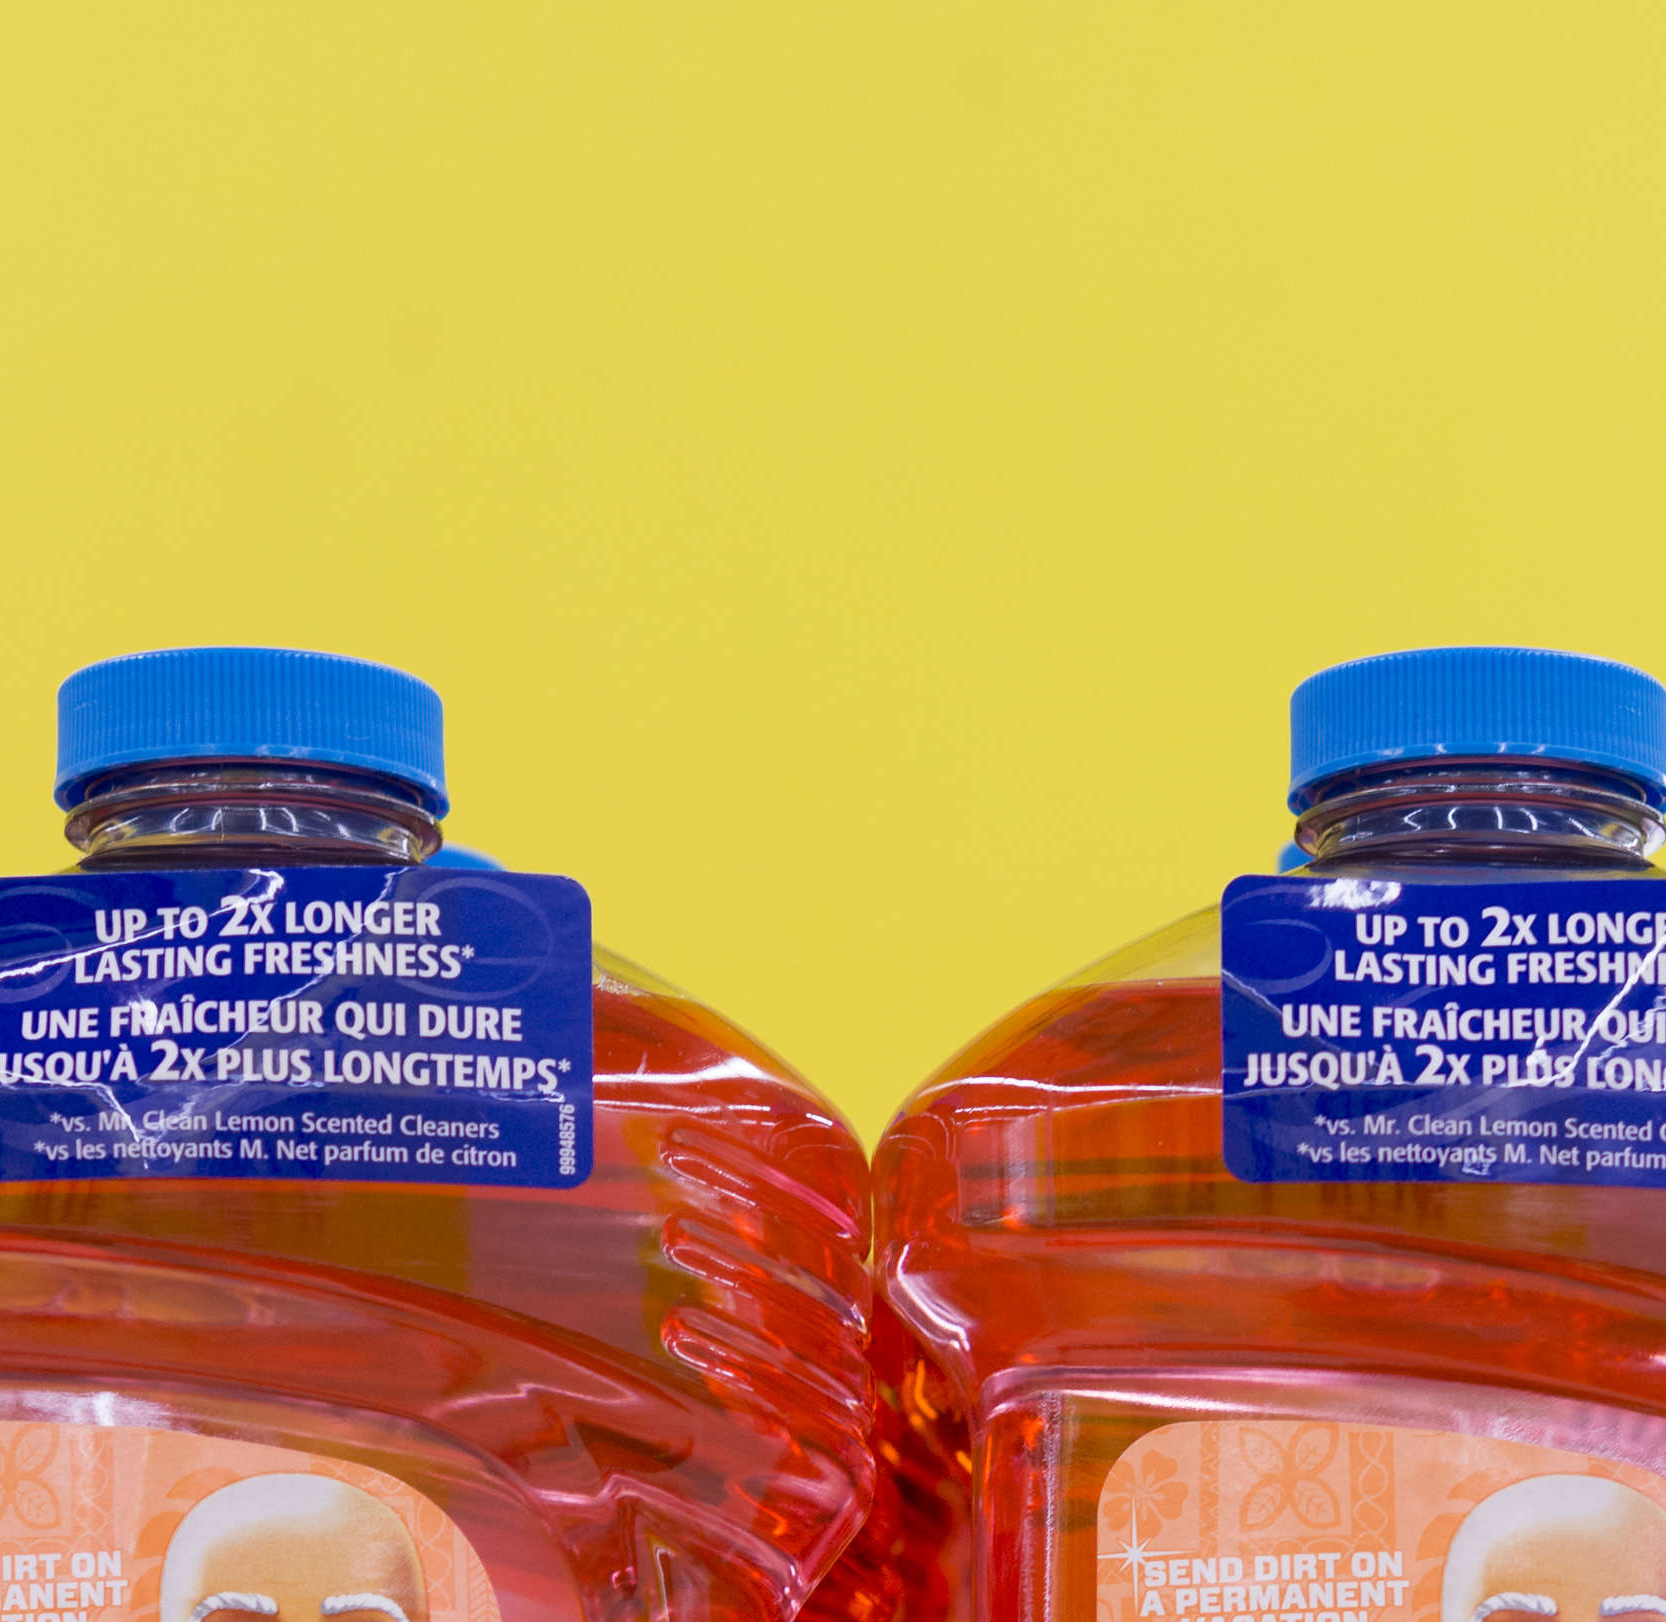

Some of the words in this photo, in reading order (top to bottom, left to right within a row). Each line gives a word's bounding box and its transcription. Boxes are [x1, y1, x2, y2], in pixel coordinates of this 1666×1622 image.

[95, 909, 147, 943] UP
[157, 907, 208, 940] TO
[285, 902, 442, 937] LONGER
[1356, 913, 1407, 946] UP
[1417, 915, 1470, 948] TO
[75, 944, 232, 984] LASTING
[1334, 951, 1499, 986] LASTING
[21, 1007, 99, 1040] UNE
[109, 993, 323, 1036] FRAÎCHEUR
[335, 1003, 406, 1038] QUI
[419, 1005, 523, 1042] DURE
[1281, 1004, 1361, 1038] UNE
[1372, 1003, 1585, 1043] FRAÎCHEUR
[1598, 1012, 1666, 1045] QUI
[216, 1048, 311, 1081] PLUS
[1243, 1044, 1403, 1087] JUSQU'À
[1482, 1054, 1576, 1089] PLUS
[559, 1103, 576, 1176] 99948576
[1363, 1115, 1400, 1135] Mr.
[1408, 1114, 1472, 1137] Clean
[1478, 1115, 1559, 1140] Lemon
[1564, 1117, 1654, 1143] Scented
[1339, 1141, 1371, 1162] les
[1377, 1141, 1497, 1168] nettoyants
[1503, 1144, 1532, 1164] M.
[1539, 1145, 1580, 1166] Net
[70, 1551, 122, 1579] ON
